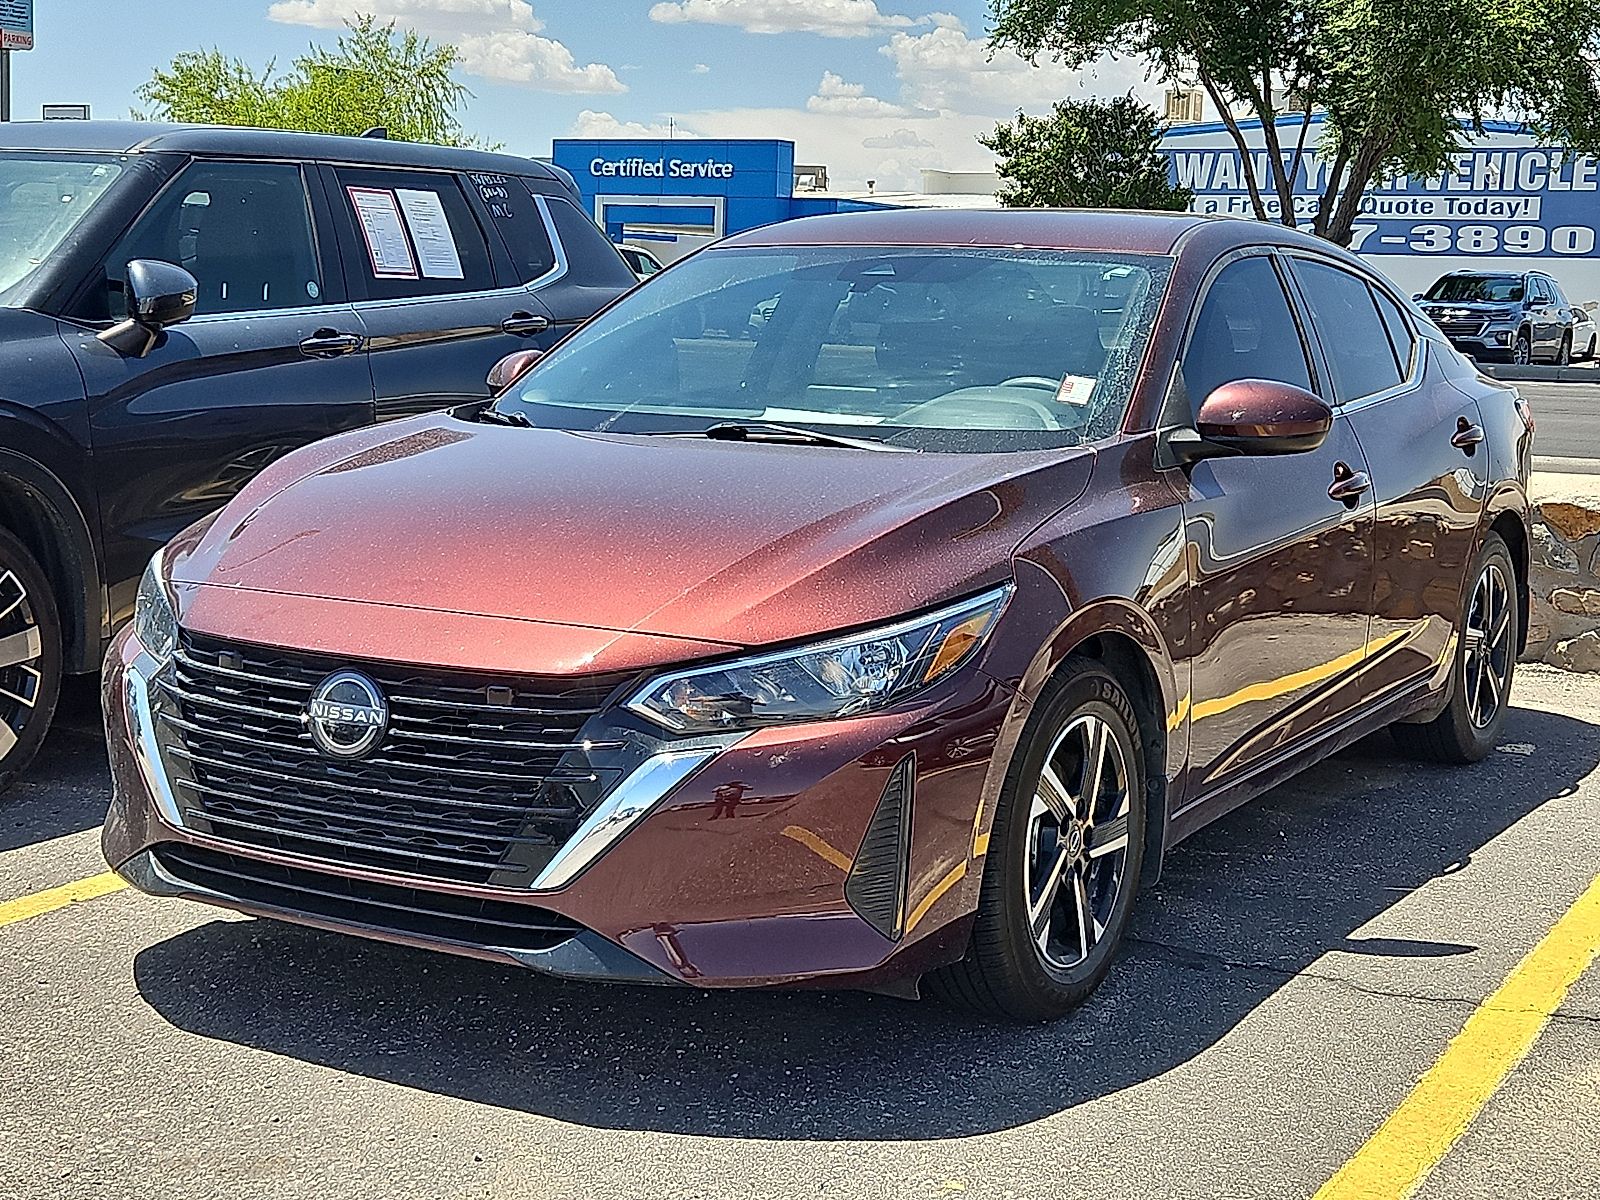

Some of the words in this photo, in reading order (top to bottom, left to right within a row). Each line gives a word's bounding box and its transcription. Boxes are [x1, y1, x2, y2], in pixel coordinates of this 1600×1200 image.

[3, 33, 32, 46] PARKING
[590, 158, 665, 178] Certified
[669, 159, 733, 178] Service
[1204, 200, 1218, 214] a
[1361, 197, 1434, 215] Quote
[1444, 198, 1530, 218] Today!
[1297, 223, 1596, 254] 7-3890
[311, 702, 384, 725] NISSAN
